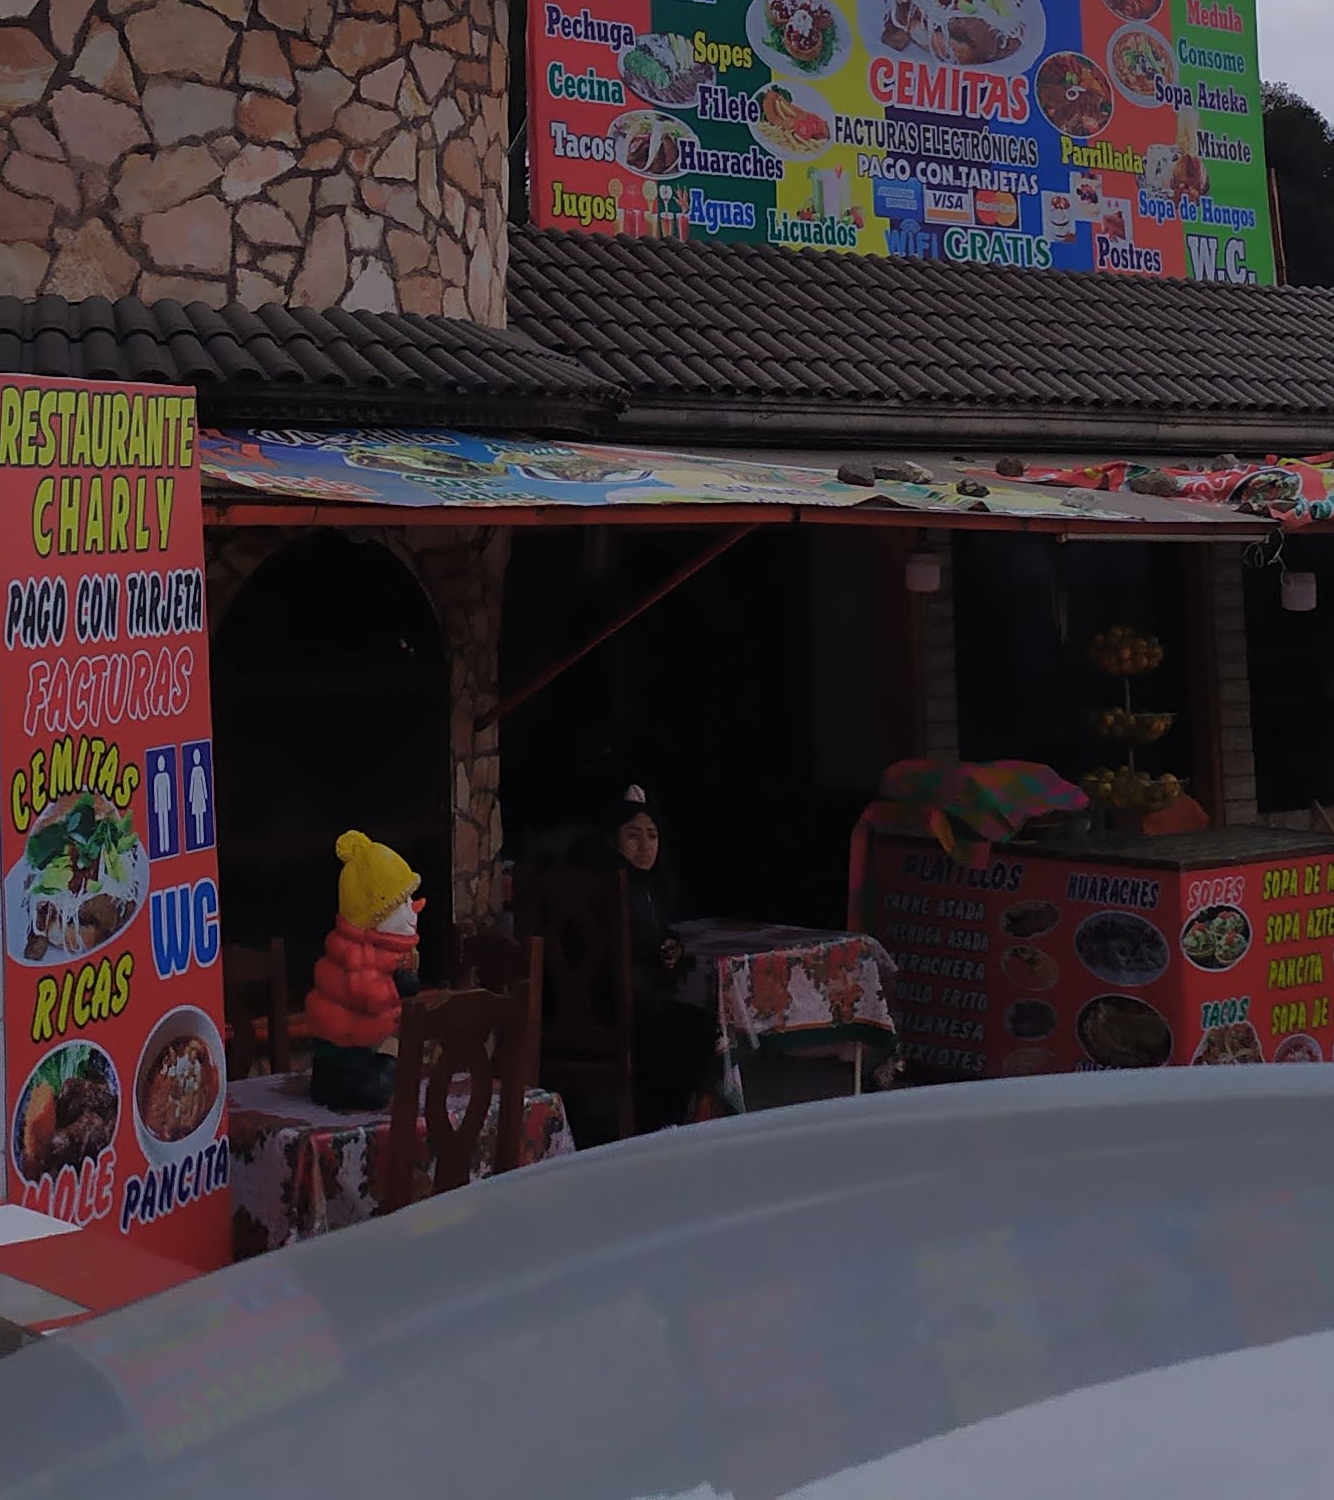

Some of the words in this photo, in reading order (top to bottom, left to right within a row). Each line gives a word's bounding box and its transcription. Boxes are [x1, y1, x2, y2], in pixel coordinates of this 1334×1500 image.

[546, 5, 634, 52] Pechuga
[692, 31, 754, 69] Sopes
[1178, 37, 1246, 74] Consome
[548, 63, 625, 105] Cecina
[697, 83, 760, 123] Filete
[869, 56, 1030, 125] CEMITAS
[1154, 75, 1193, 111] Sopa
[1197, 82, 1248, 114] Azteka
[551, 123, 616, 162] Tacos
[678, 138, 784, 181] Huaraches
[835, 115, 917, 153] FACTURAS
[921, 126, 1038, 168] ELECTRÓNICAS
[1060, 135, 1144, 174] Parrillada
[1196, 131, 1252, 163] Mixiote
[858, 153, 911, 181] PAGO
[917, 162, 959, 186] CON
[959, 166, 1038, 195] TARJETAS
[553, 180, 616, 224] Jugos
[689, 189, 756, 231] Aguas
[932, 192, 964, 211] VISA
[1138, 190, 1176, 224] Sopa
[1179, 196, 1197, 222] de
[1200, 197, 1255, 231] Hongos
[768, 209, 857, 249] Licuados
[943, 228, 1052, 269] GRATIS
[1097, 235, 1162, 273] Postres
[32, 475, 174, 556] CHARLY
[5, 575, 66, 651] PAGO
[75, 572, 120, 644] CON
[126, 567, 203, 639] TARJETA
[24, 645, 193, 736] FACTURAS
[11, 735, 140, 833] CEMITAS
[1067, 872, 1161, 908] HUARACHES
[1187, 876, 1245, 911] SOPES
[1263, 868, 1298, 900] SOPA
[1304, 865, 1321, 894] DE
[148, 876, 219, 979] WC
[1266, 912, 1300, 945] SOPA
[1268, 954, 1323, 989] PANCITA
[31, 951, 134, 1044] RICAS
[1201, 996, 1250, 1029] TACOS
[1272, 1001, 1307, 1035] SOPA
[21, 1145, 116, 1228] MOLE
[120, 1135, 231, 1235] PANCITA
